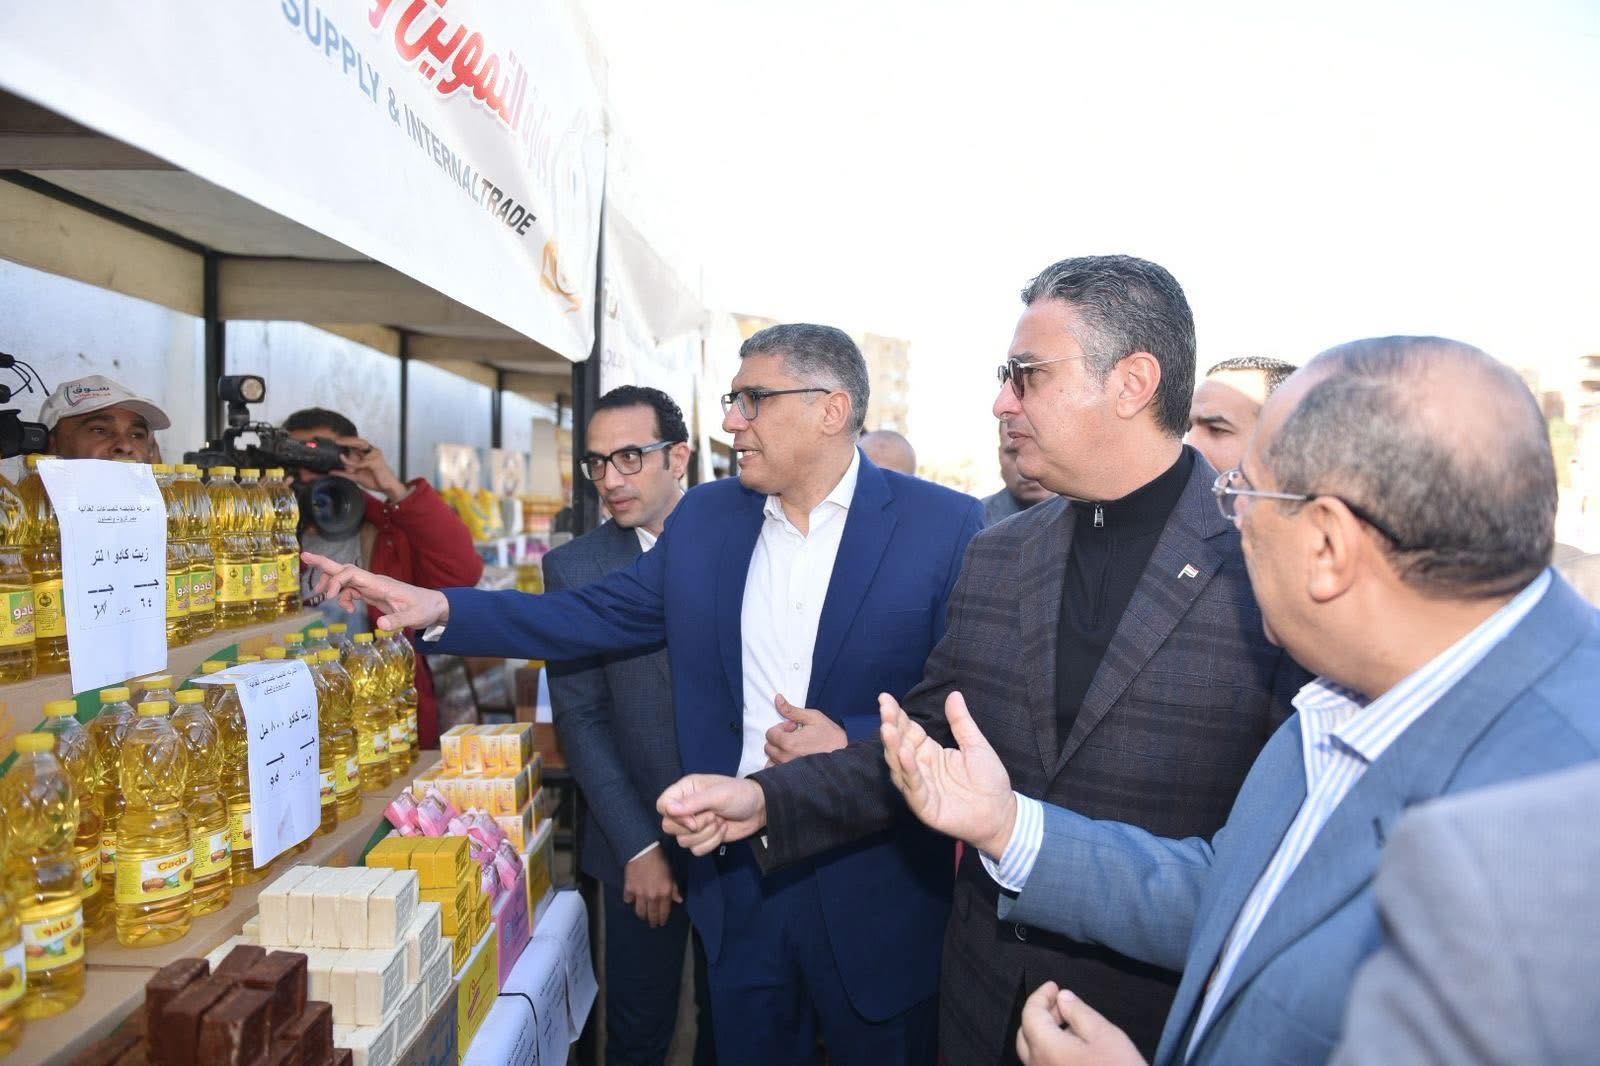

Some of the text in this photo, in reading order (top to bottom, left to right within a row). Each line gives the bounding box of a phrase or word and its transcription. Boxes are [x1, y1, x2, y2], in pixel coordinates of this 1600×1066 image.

[281, 0, 380, 104] SUPPLY
[387, 86, 401, 127] &
[394, 0, 527, 131] التموين
[91, 549, 104, 566] لتر
[113, 548, 129, 564] كادو
[132, 547, 149, 562] زيت
[288, 711, 300, 729] كادو
[300, 706, 312, 721] زيت
[260, 724, 270, 741] مل
[82, 855, 99, 870] ado
[157, 856, 188, 872] Cado
